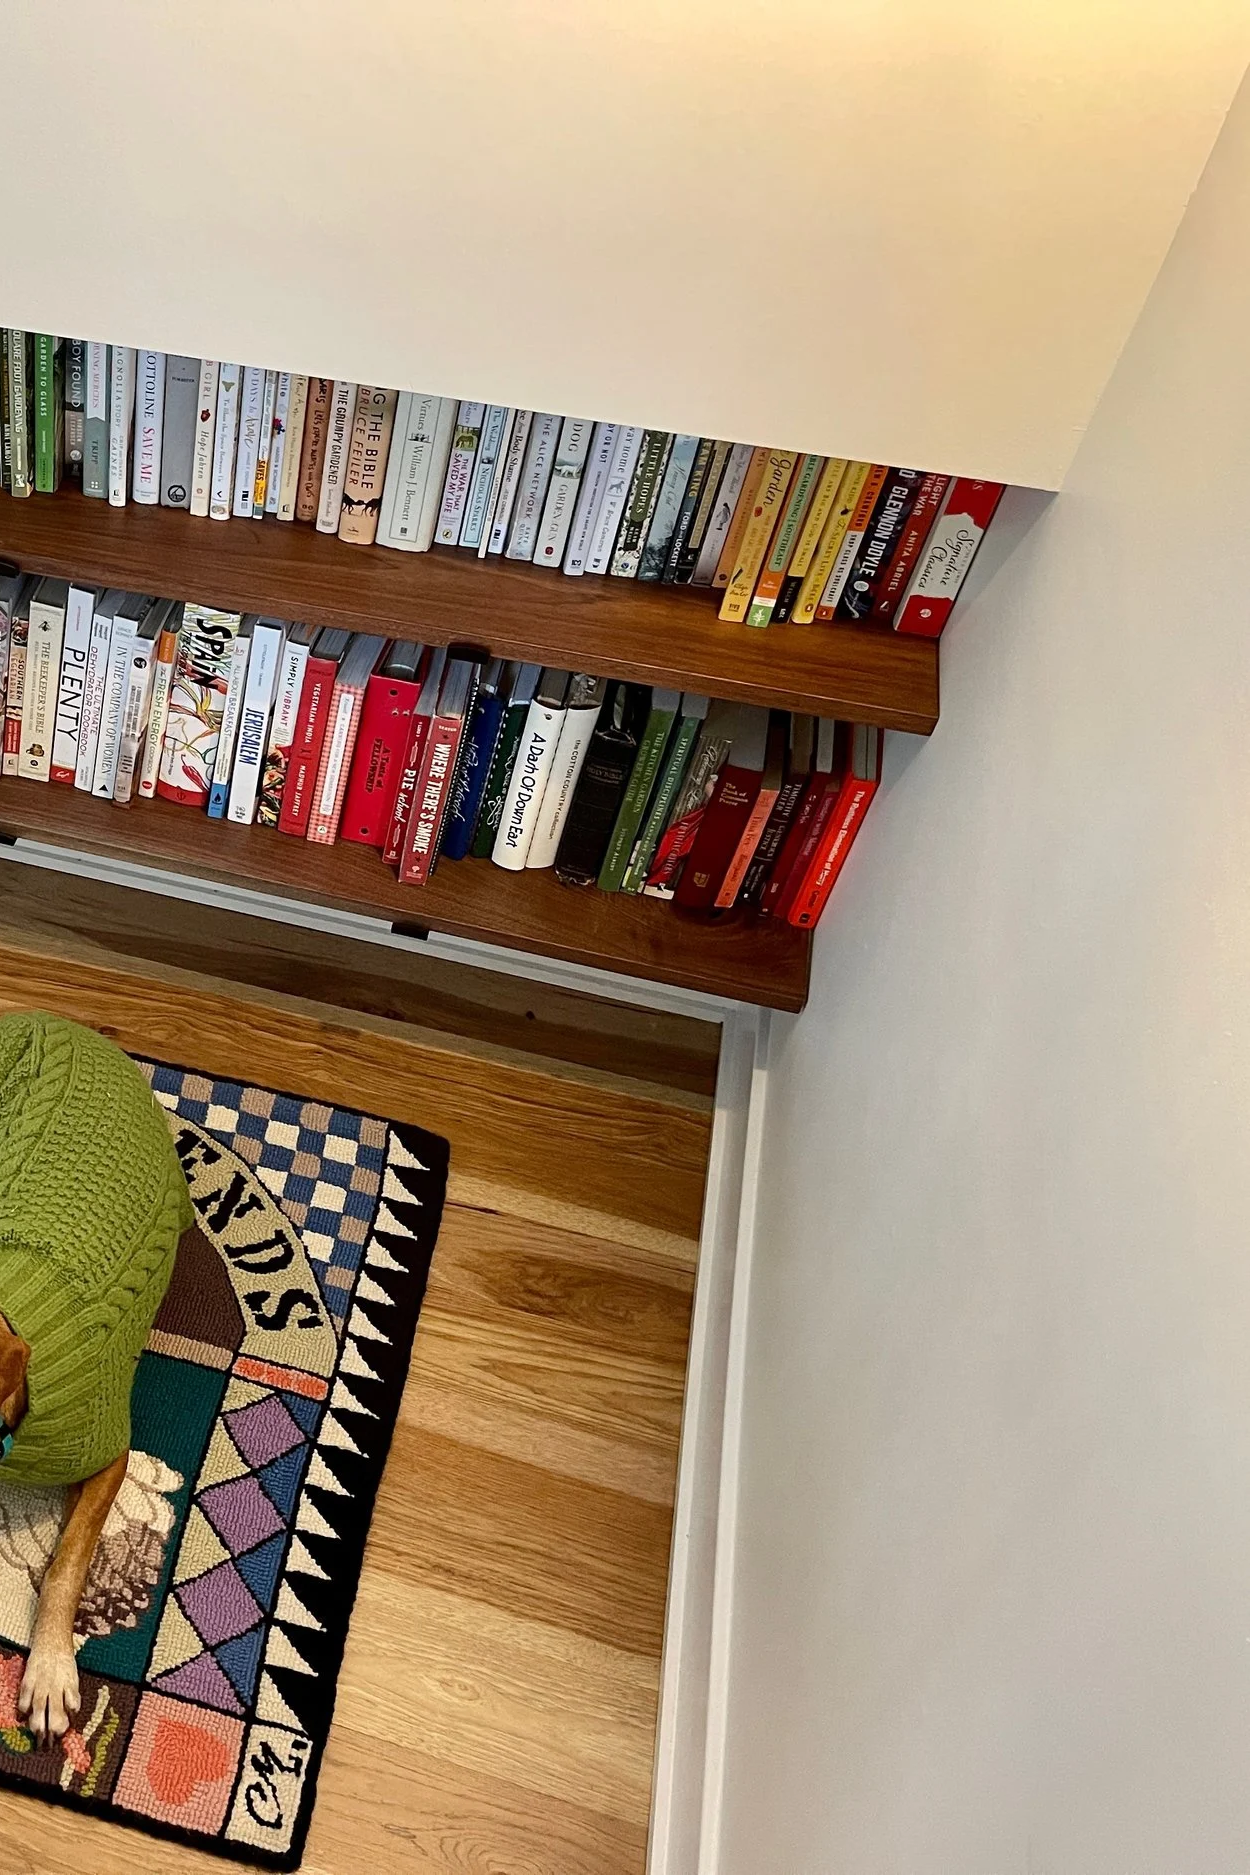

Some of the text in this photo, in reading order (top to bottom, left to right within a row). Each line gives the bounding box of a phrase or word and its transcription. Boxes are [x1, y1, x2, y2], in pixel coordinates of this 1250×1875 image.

[40, 376, 47, 387] TO
[71, 339, 81, 407] BOY FOUND
[203, 372, 213, 400] GIRL
[337, 389, 349, 405] THE
[333, 407, 347, 444] GRUMPY
[349, 388, 371, 485] BRUCE FEILER
[368, 412, 384, 441] THE
[417, 399, 432, 430] Virtues
[199, 430, 209, 451] Hope
[409, 445, 424, 479] William
[197, 452, 208, 479] Jahren
[257, 459, 266, 480] SAVES
[328, 445, 342, 485] GARDENER
[361, 448, 378, 489] BIBLE
[444, 453, 462, 513] SAVED MY LIFE
[453, 458, 469, 511] THE WAR THAT
[524, 417, 553, 519] THE ALICE NETWORK
[548, 423, 583, 541] DOG GARDEN GUN
[636, 443, 662, 514] LITTLE HOPES
[762, 457, 791, 507] garden
[402, 489, 416, 521] Bennett
[873, 485, 908, 539] GLENNON
[912, 474, 937, 516] THE WAR
[927, 477, 946, 506] LIGHT
[670, 511, 690, 567] FORD LOCKETT
[859, 540, 886, 576] DOYLE
[888, 530, 918, 592] ANITA ABRIEL
[939, 529, 975, 585] Signature
[918, 546, 947, 588] Classics
[9, 653, 17, 699] VEGETARIAN
[16, 659, 25, 700] SOUTHERN
[35, 641, 51, 733] THE BEEKEEPER'S BIBLE
[56, 646, 86, 742] PLENTY
[154, 677, 166, 707] FRESH
[79, 646, 98, 757] DEHYDRATOR COOKBOOK
[89, 676, 104, 736] THE ULTIMATE
[101, 646, 128, 776] IN THE COMPANY OF WOMEN
[224, 665, 241, 737] ALL ABOUT BREAKFAST
[280, 690, 294, 727] VIBRANT
[149, 709, 163, 745] ENERGY
[239, 707, 265, 765] JERUSALEM
[292, 682, 322, 817] VEGETARIAN INDIA MADHUR JAFFREY
[364, 738, 383, 793] FELLOWSHIP
[632, 732, 665, 813] THE KITCHEN GARDEN
[668, 737, 689, 775] SPIRITUAL
[395, 768, 416, 822] PIE school
[413, 743, 452, 854] WHERE THERE'S SMOKE
[506, 732, 546, 848] A Dash Of Down East
[549, 739, 581, 840] the COTTON COUNTRY collection
[652, 776, 675, 820] DISCIPLINES
[775, 784, 792, 811] KELLER
[782, 783, 803, 817] TIMOTHY
